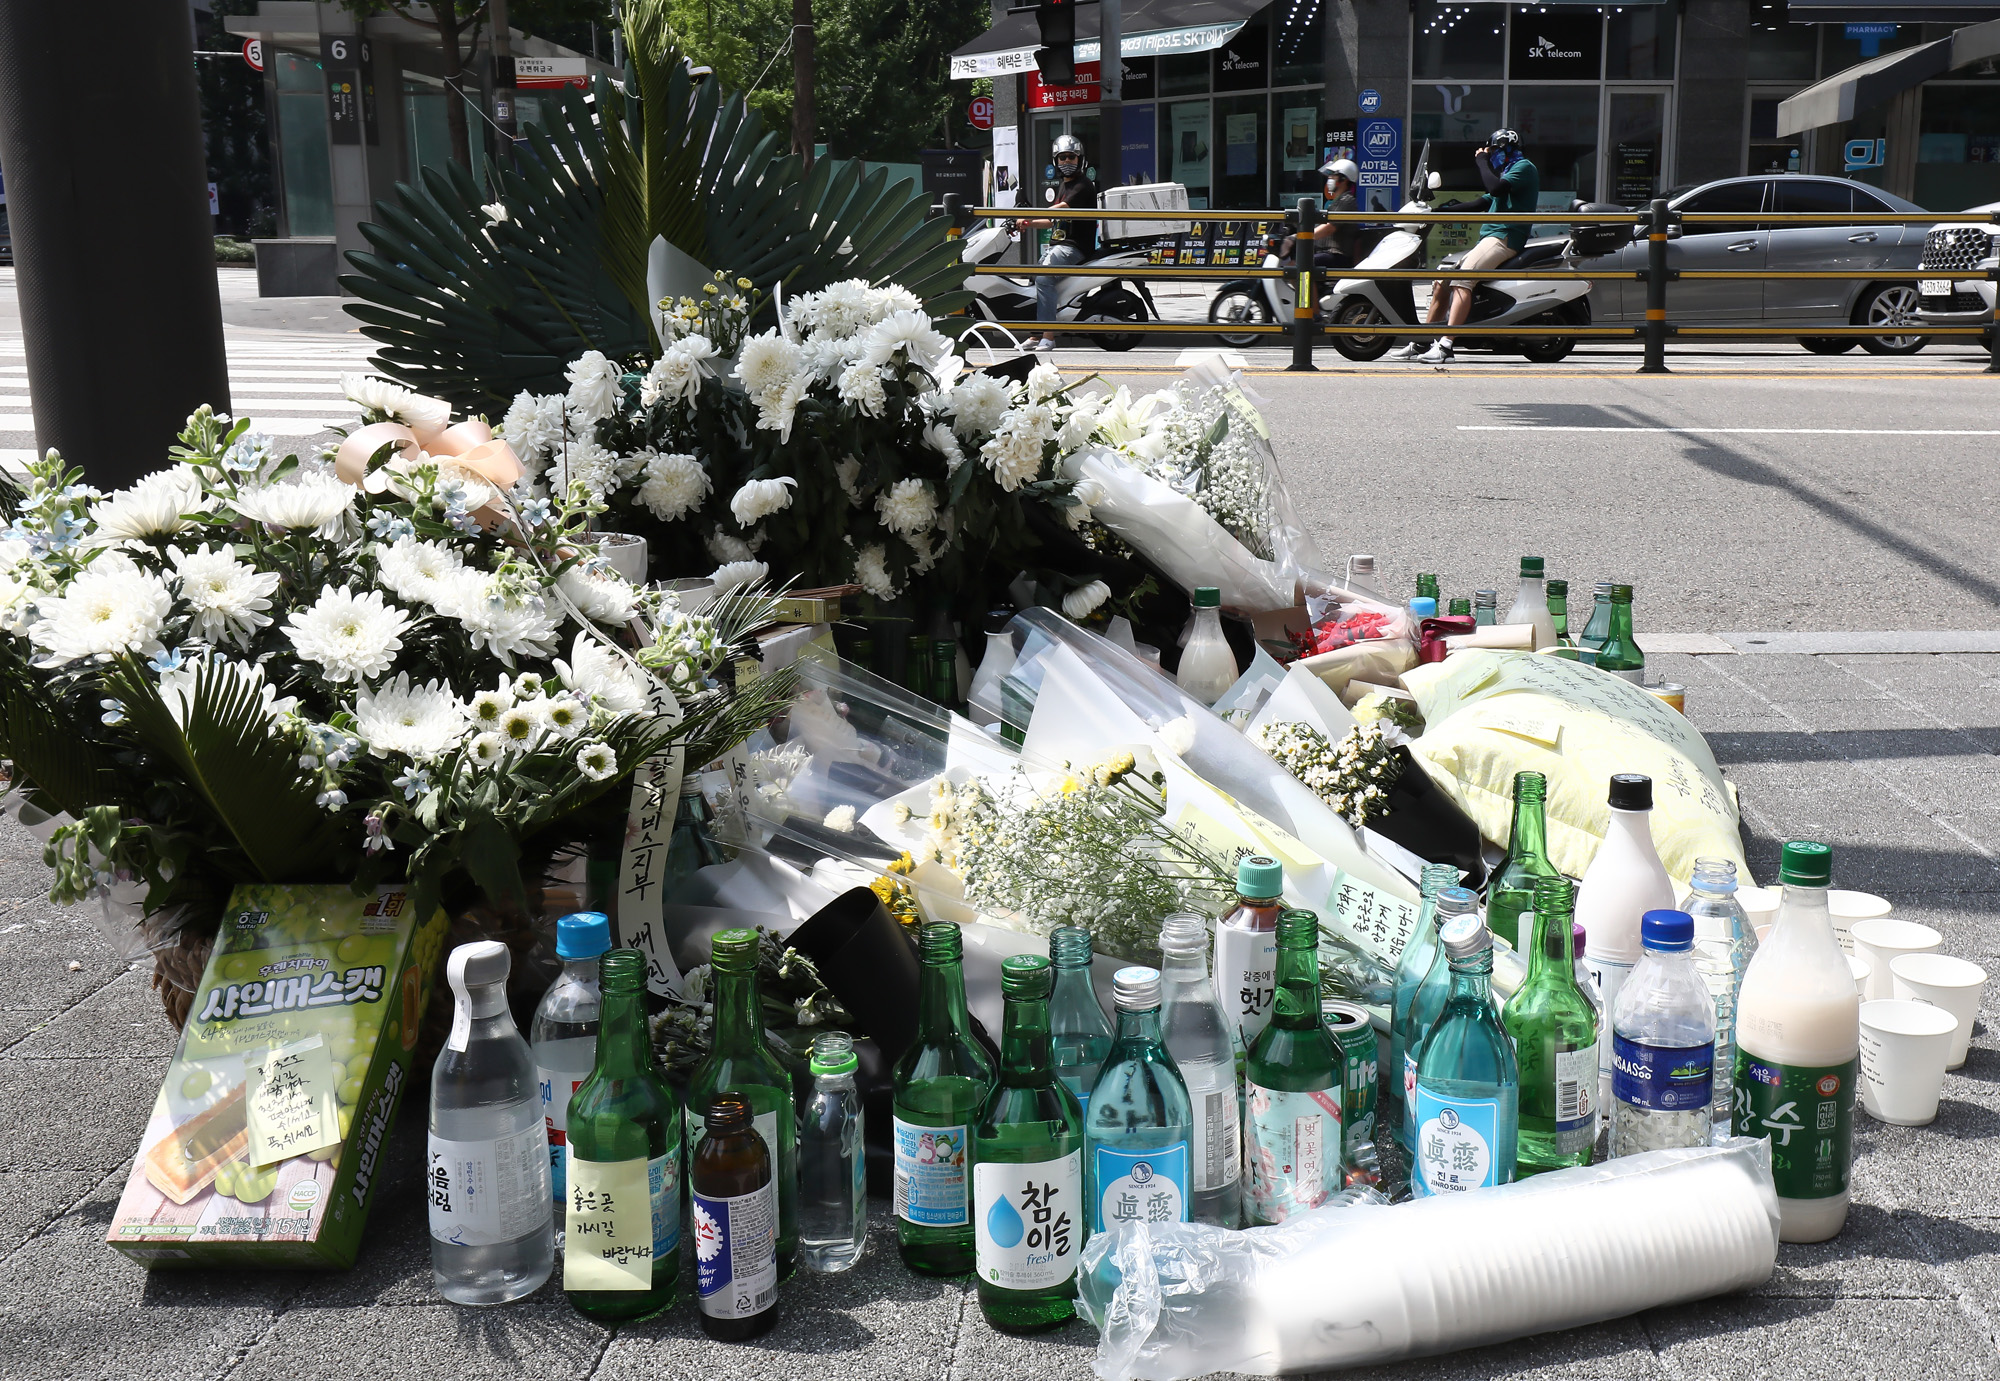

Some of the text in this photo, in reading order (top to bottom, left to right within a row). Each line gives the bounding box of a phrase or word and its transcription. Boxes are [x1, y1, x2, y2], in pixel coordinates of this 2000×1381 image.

[1846, 25, 1895, 34] PHARMACY
[250, 46, 262, 61] 5
[331, 40, 348, 60] 6
[361, 43, 370, 62] 6
[1528, 47, 1582, 58] SK telecom
[519, 65, 553, 73] 우편취급국
[952, 58, 978, 74] 가격은
[997, 52, 1023, 70] 혜택은
[1222, 60, 1260, 71] SK telecom
[1125, 71, 1148, 81] telecom
[1041, 88, 1089, 103] 공식 인증 대리점
[1361, 96, 1379, 106] ADT
[972, 101, 994, 125] 약
[1326, 130, 1354, 143] 업무용폰
[1368, 132, 1391, 147] ADT
[1360, 160, 1398, 171] ADT캡스
[1360, 173, 1399, 185] 도어가드
[258, 957, 330, 978] 후렌치파이
[1243, 970, 1270, 982] 갈증에
[198, 965, 383, 1022] 샤인머스캣
[1349, 1057, 1378, 1091] ite
[1751, 1067, 1772, 1084] 서울
[1631, 1095, 1641, 1104] 500
[1819, 1103, 1836, 1113] 서울
[1733, 1086, 1806, 1147] 장수
[1437, 1127, 1451, 1135] SINCE
[1437, 1170, 1460, 1184] 진로
[1430, 1179, 1467, 1192] JINRO SOJU
[293, 1190, 317, 1198] HACCP
[574, 1183, 615, 1214] 좋은 곳
[576, 1221, 617, 1239] 가시길
[601, 1245, 654, 1266] 바랍니다
[1026, 1252, 1054, 1266] fresh
